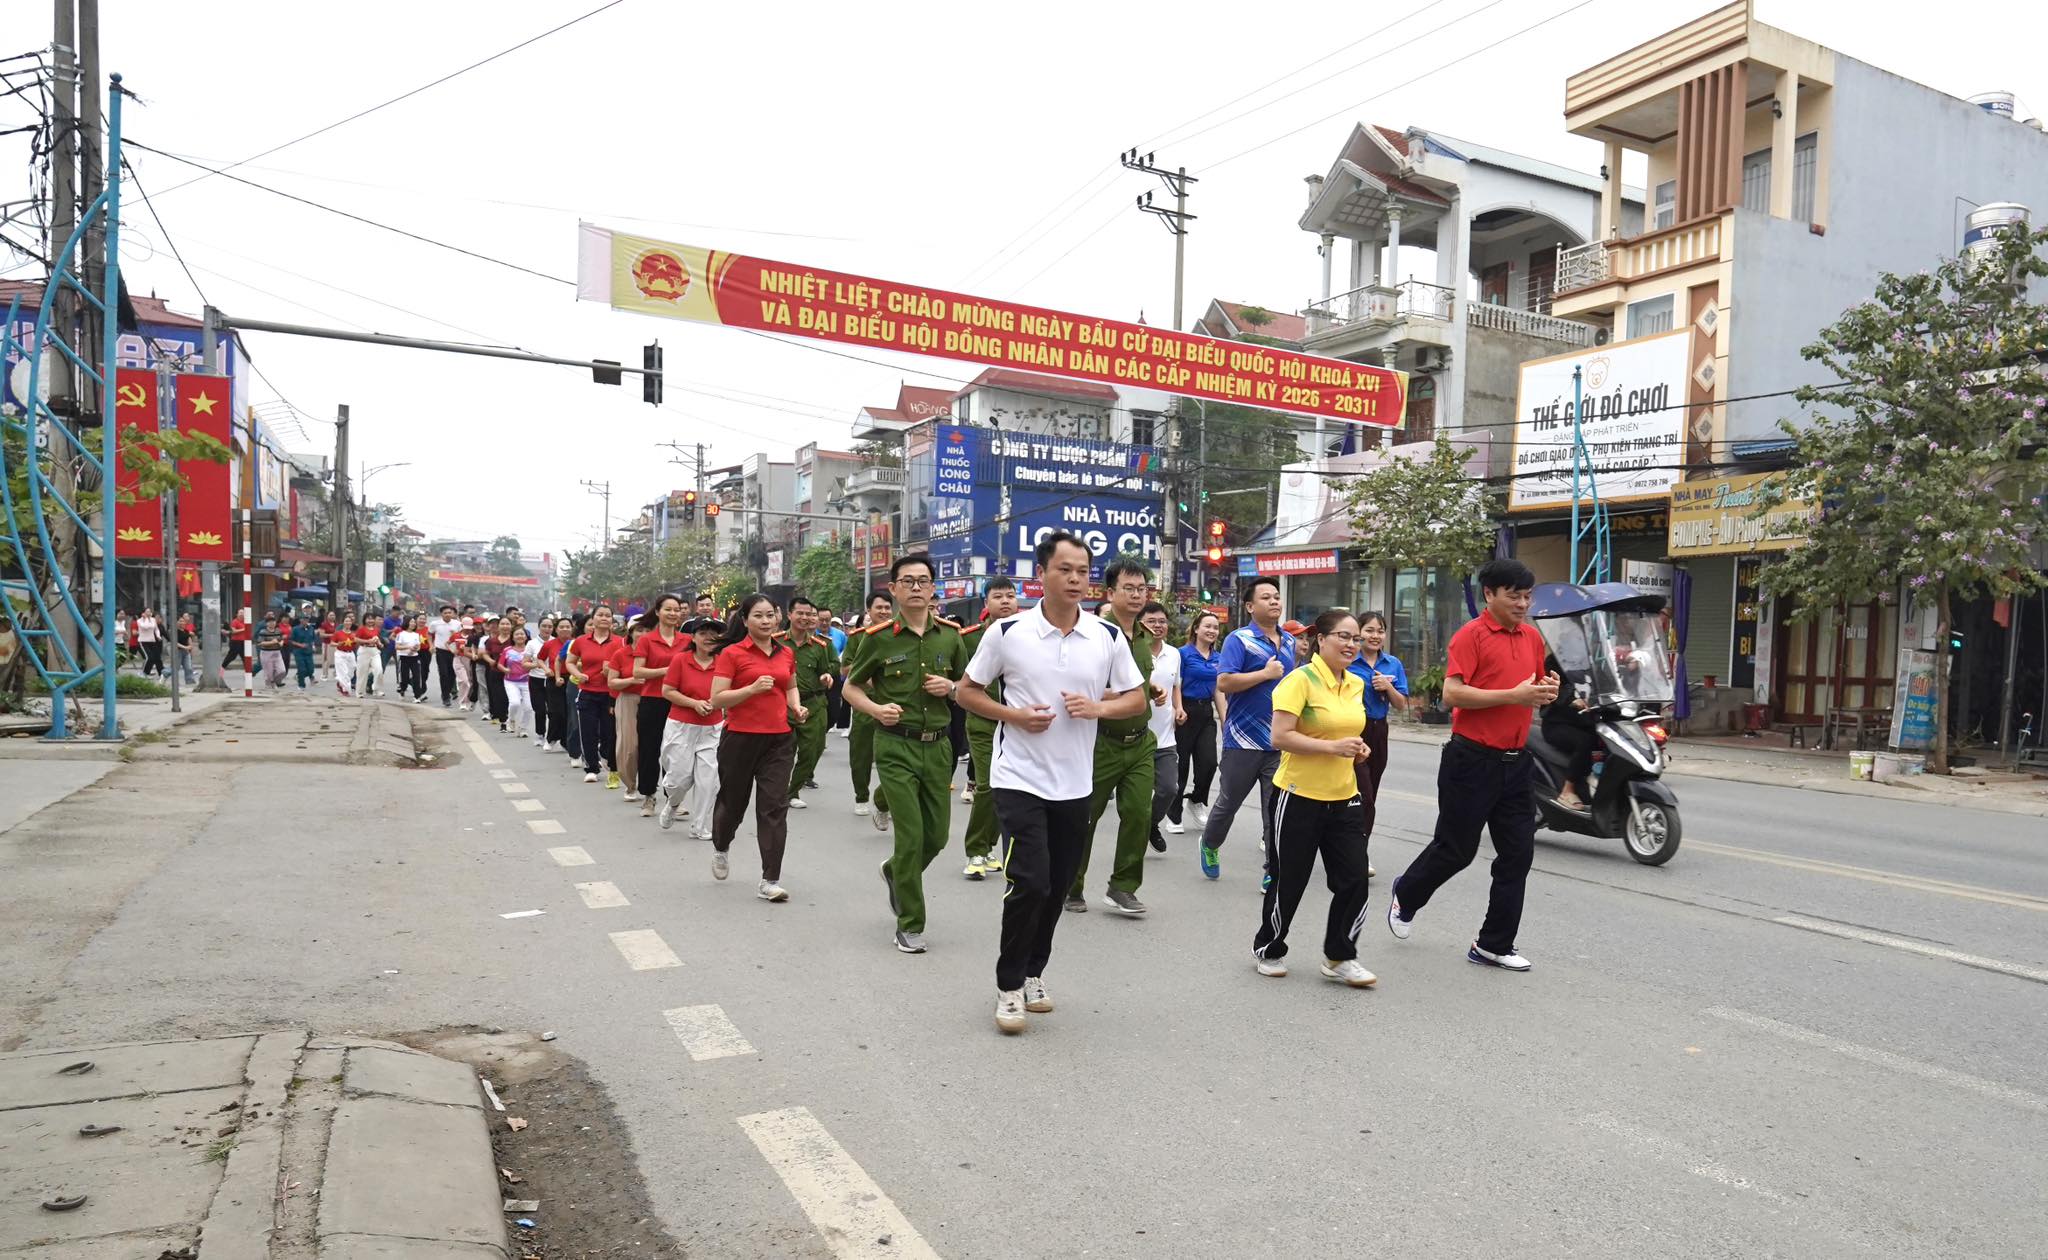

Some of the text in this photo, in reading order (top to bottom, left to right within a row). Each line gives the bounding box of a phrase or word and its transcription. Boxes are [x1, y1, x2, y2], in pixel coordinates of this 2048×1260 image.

[760, 269, 1380, 393] NHIỆT LIỆT CHÀO MỪNG NGÀY BẦU CỬ ĐẠI BIỂU QUỐC HỘI KHOÁ XVI
[761, 298, 792, 326] VÀ
[798, 306, 837, 336] ĐẠI
[844, 310, 896, 342] BIỂU
[902, 322, 938, 352] HỘI
[944, 326, 1002, 359] ĐỒNG
[1008, 340, 1064, 368] NHÂN
[1069, 348, 1109, 375] DÂN
[1114, 356, 1151, 381] CÁC
[1156, 361, 1191, 387] CẤP
[1195, 371, 1252, 398] NHIỆM
[1256, 380, 1278, 401] KỲ
[1281, 385, 1320, 408] 2026
[1334, 394, 1377, 417] 2031!
[910, 401, 949, 416] HOÀNG
[1533, 382, 1669, 432] THẾ GỚI ĐỒ CHƠI
[991, 437, 1029, 458] CÔNG
[1032, 443, 1050, 460] TY
[1052, 444, 1088, 466] DƯỢC
[1530, 450, 1548, 464] CHƠI
[1550, 446, 1567, 462] GIÁO
[1569, 444, 1584, 459] DC
[1593, 442, 1609, 457] PHỤ
[1611, 437, 1631, 456] KIỆN
[1633, 435, 1662, 450] TRANG
[1664, 430, 1678, 446] TRÍ
[939, 446, 971, 494] NHÀ THUỐC LONG CHÂU
[1014, 465, 1057, 483] Chuyên
[1058, 470, 1079, 484] bán
[1126, 475, 1143, 491] nội
[1674, 488, 1691, 502] NHÀ
[1694, 487, 1713, 500] MAY
[706, 504, 718, 515] 30
[1064, 504, 1164, 528] NHÀ THUỐC
[930, 515, 971, 541] LONG CHÂU
